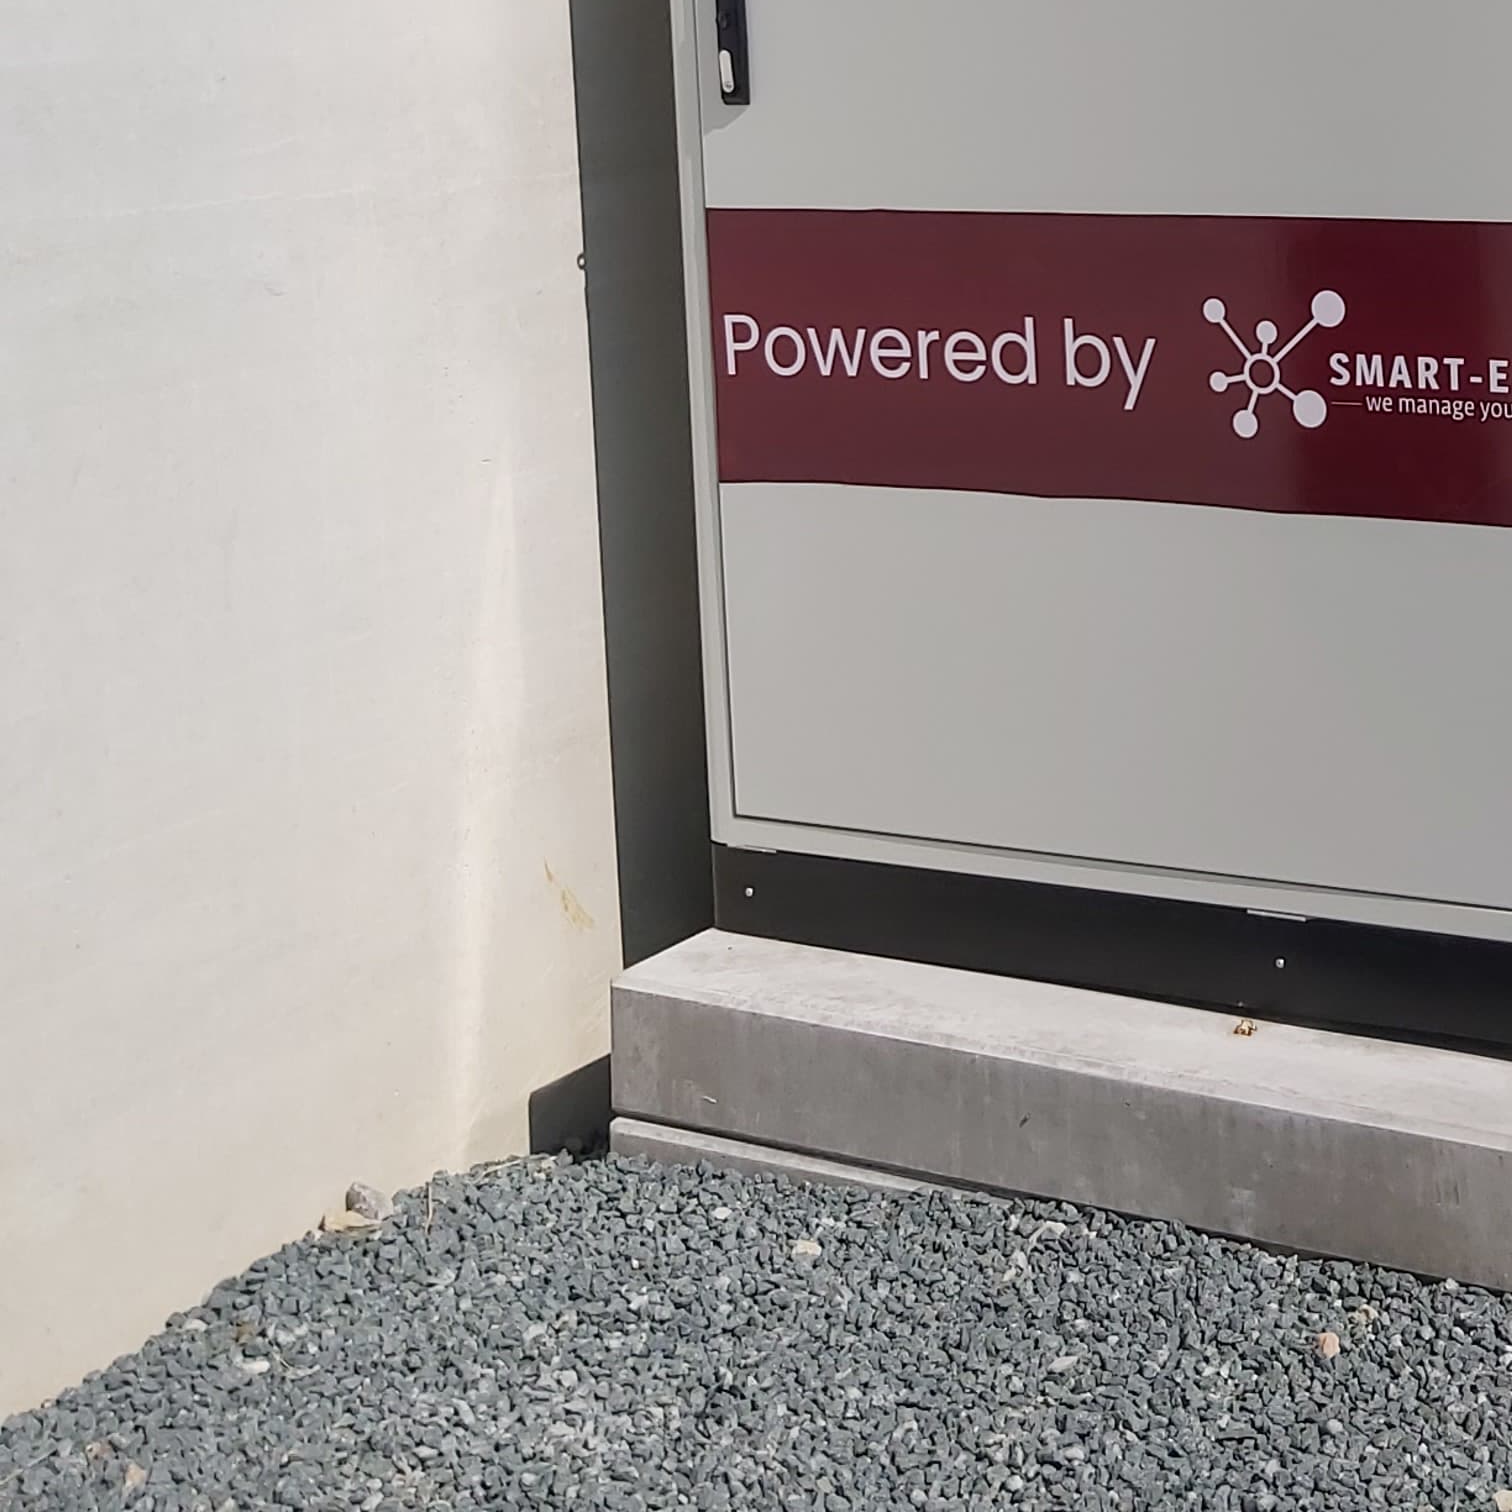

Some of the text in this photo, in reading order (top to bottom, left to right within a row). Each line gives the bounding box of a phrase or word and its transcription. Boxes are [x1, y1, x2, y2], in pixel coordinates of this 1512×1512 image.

[723, 314, 1156, 410] Powered by
[1365, 396, 1393, 412] we
[1398, 397, 1475, 421] manage
